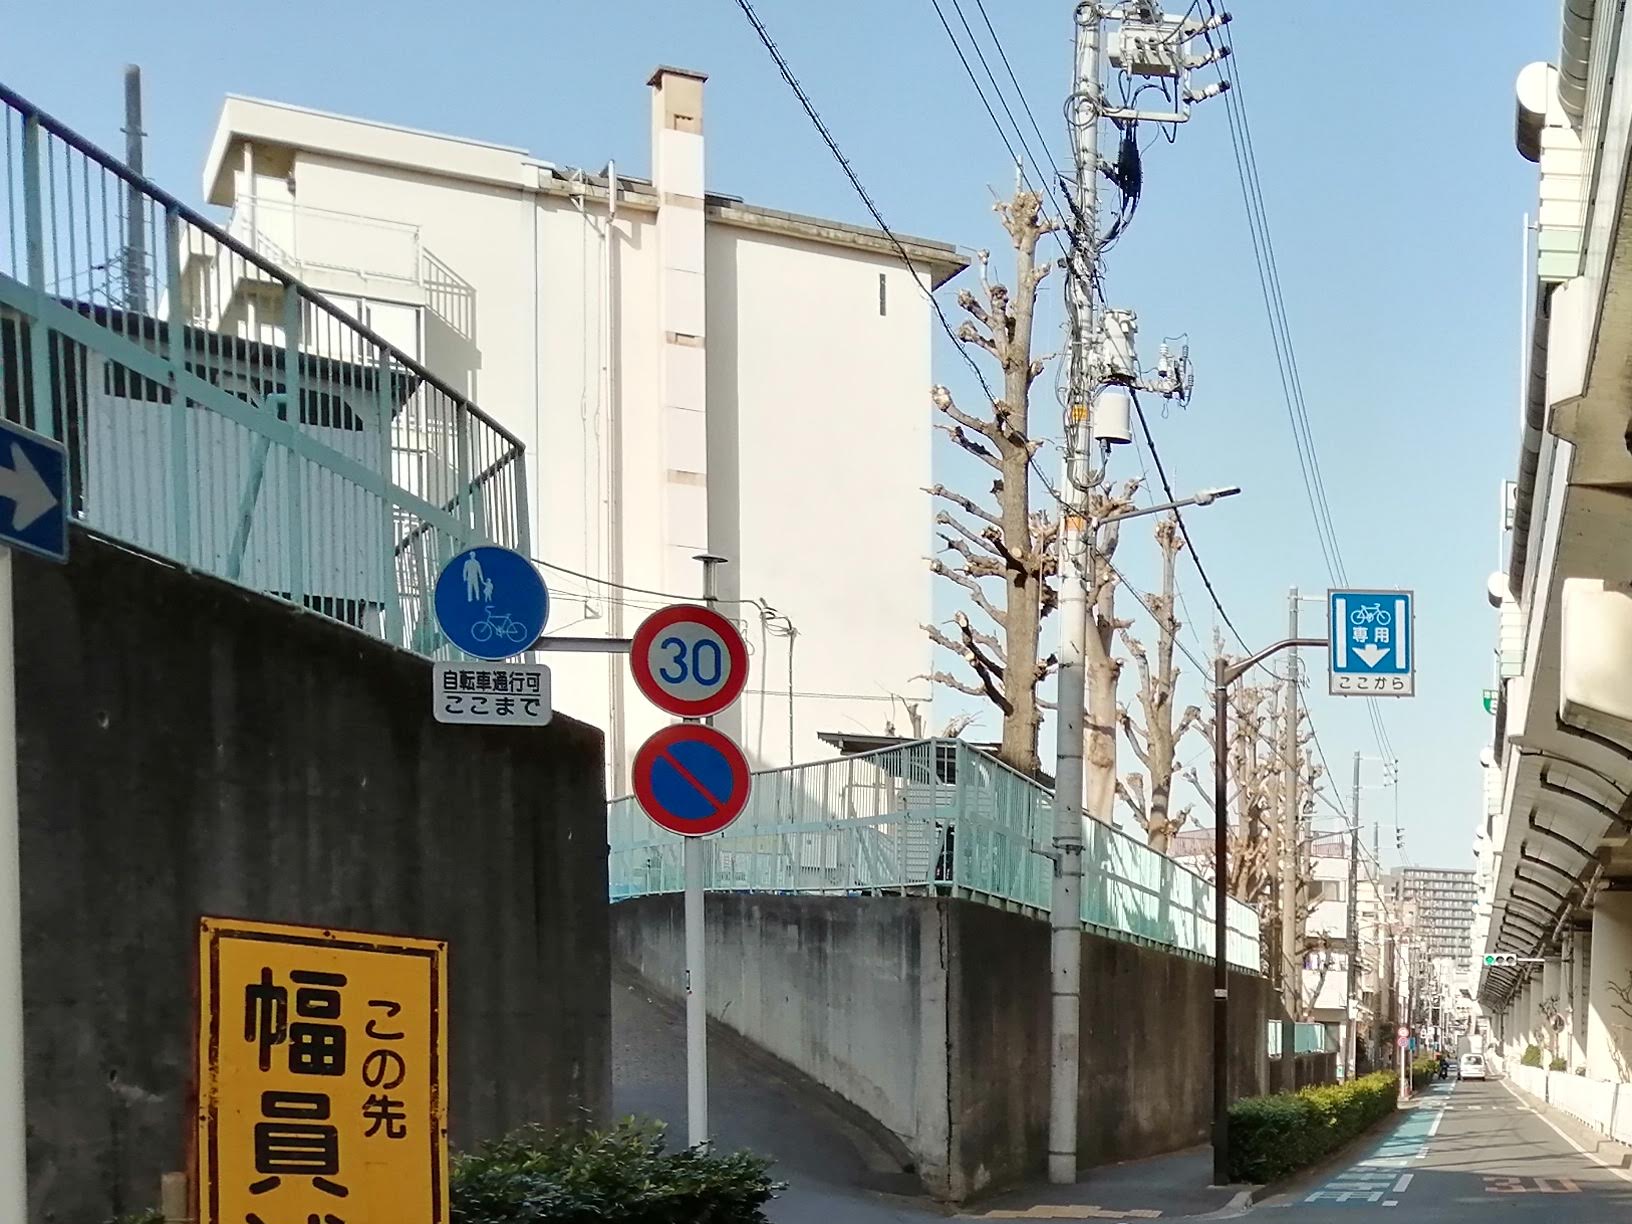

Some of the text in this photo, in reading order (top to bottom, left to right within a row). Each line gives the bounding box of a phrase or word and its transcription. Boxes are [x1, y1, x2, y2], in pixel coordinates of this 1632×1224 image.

[1352, 626, 1390, 643] 専用
[659, 637, 722, 686] 30
[443, 670, 541, 693] 自転車通行可
[1339, 676, 1404, 690] ここから
[444, 695, 541, 717] ここまで
[361, 1000, 407, 1140] この先
[1483, 1177, 1582, 1192] 30
